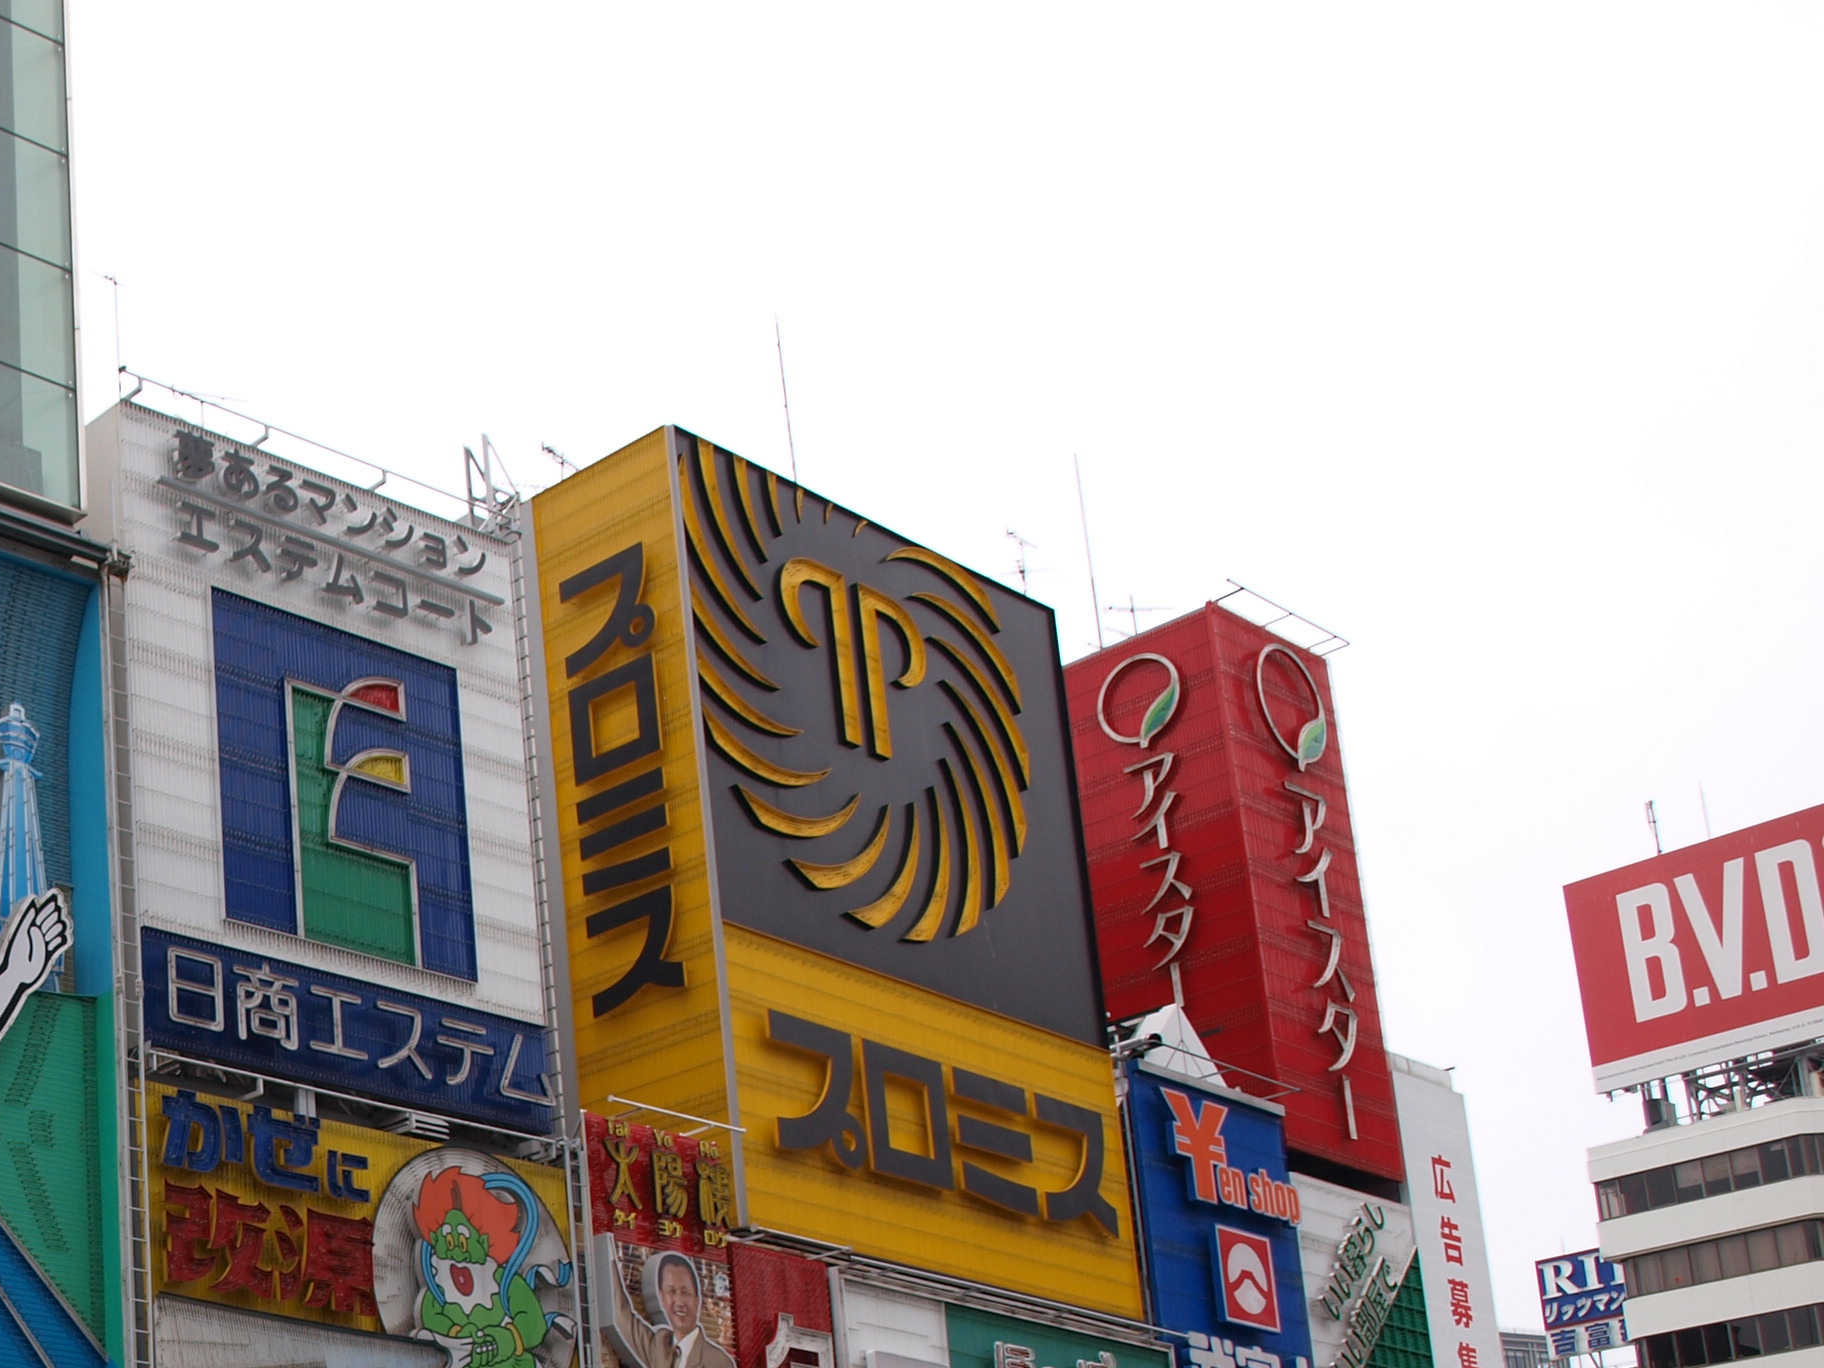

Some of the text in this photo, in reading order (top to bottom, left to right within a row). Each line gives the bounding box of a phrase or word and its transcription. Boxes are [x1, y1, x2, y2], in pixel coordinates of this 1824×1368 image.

[177, 500, 494, 646] エステムコート
[559, 541, 686, 1018] プロミス
[1123, 752, 1193, 1008] アイスター
[166, 944, 557, 1107] 日商エステム
[1284, 780, 1358, 1141] アイスター
[161, 1088, 372, 1203] かぜに
[767, 1008, 1120, 1239] プロミス
[1249, 1168, 1301, 1227] shop
[162, 1178, 377, 1317] 改源
[1317, 1201, 1386, 1323] いい暮らし
